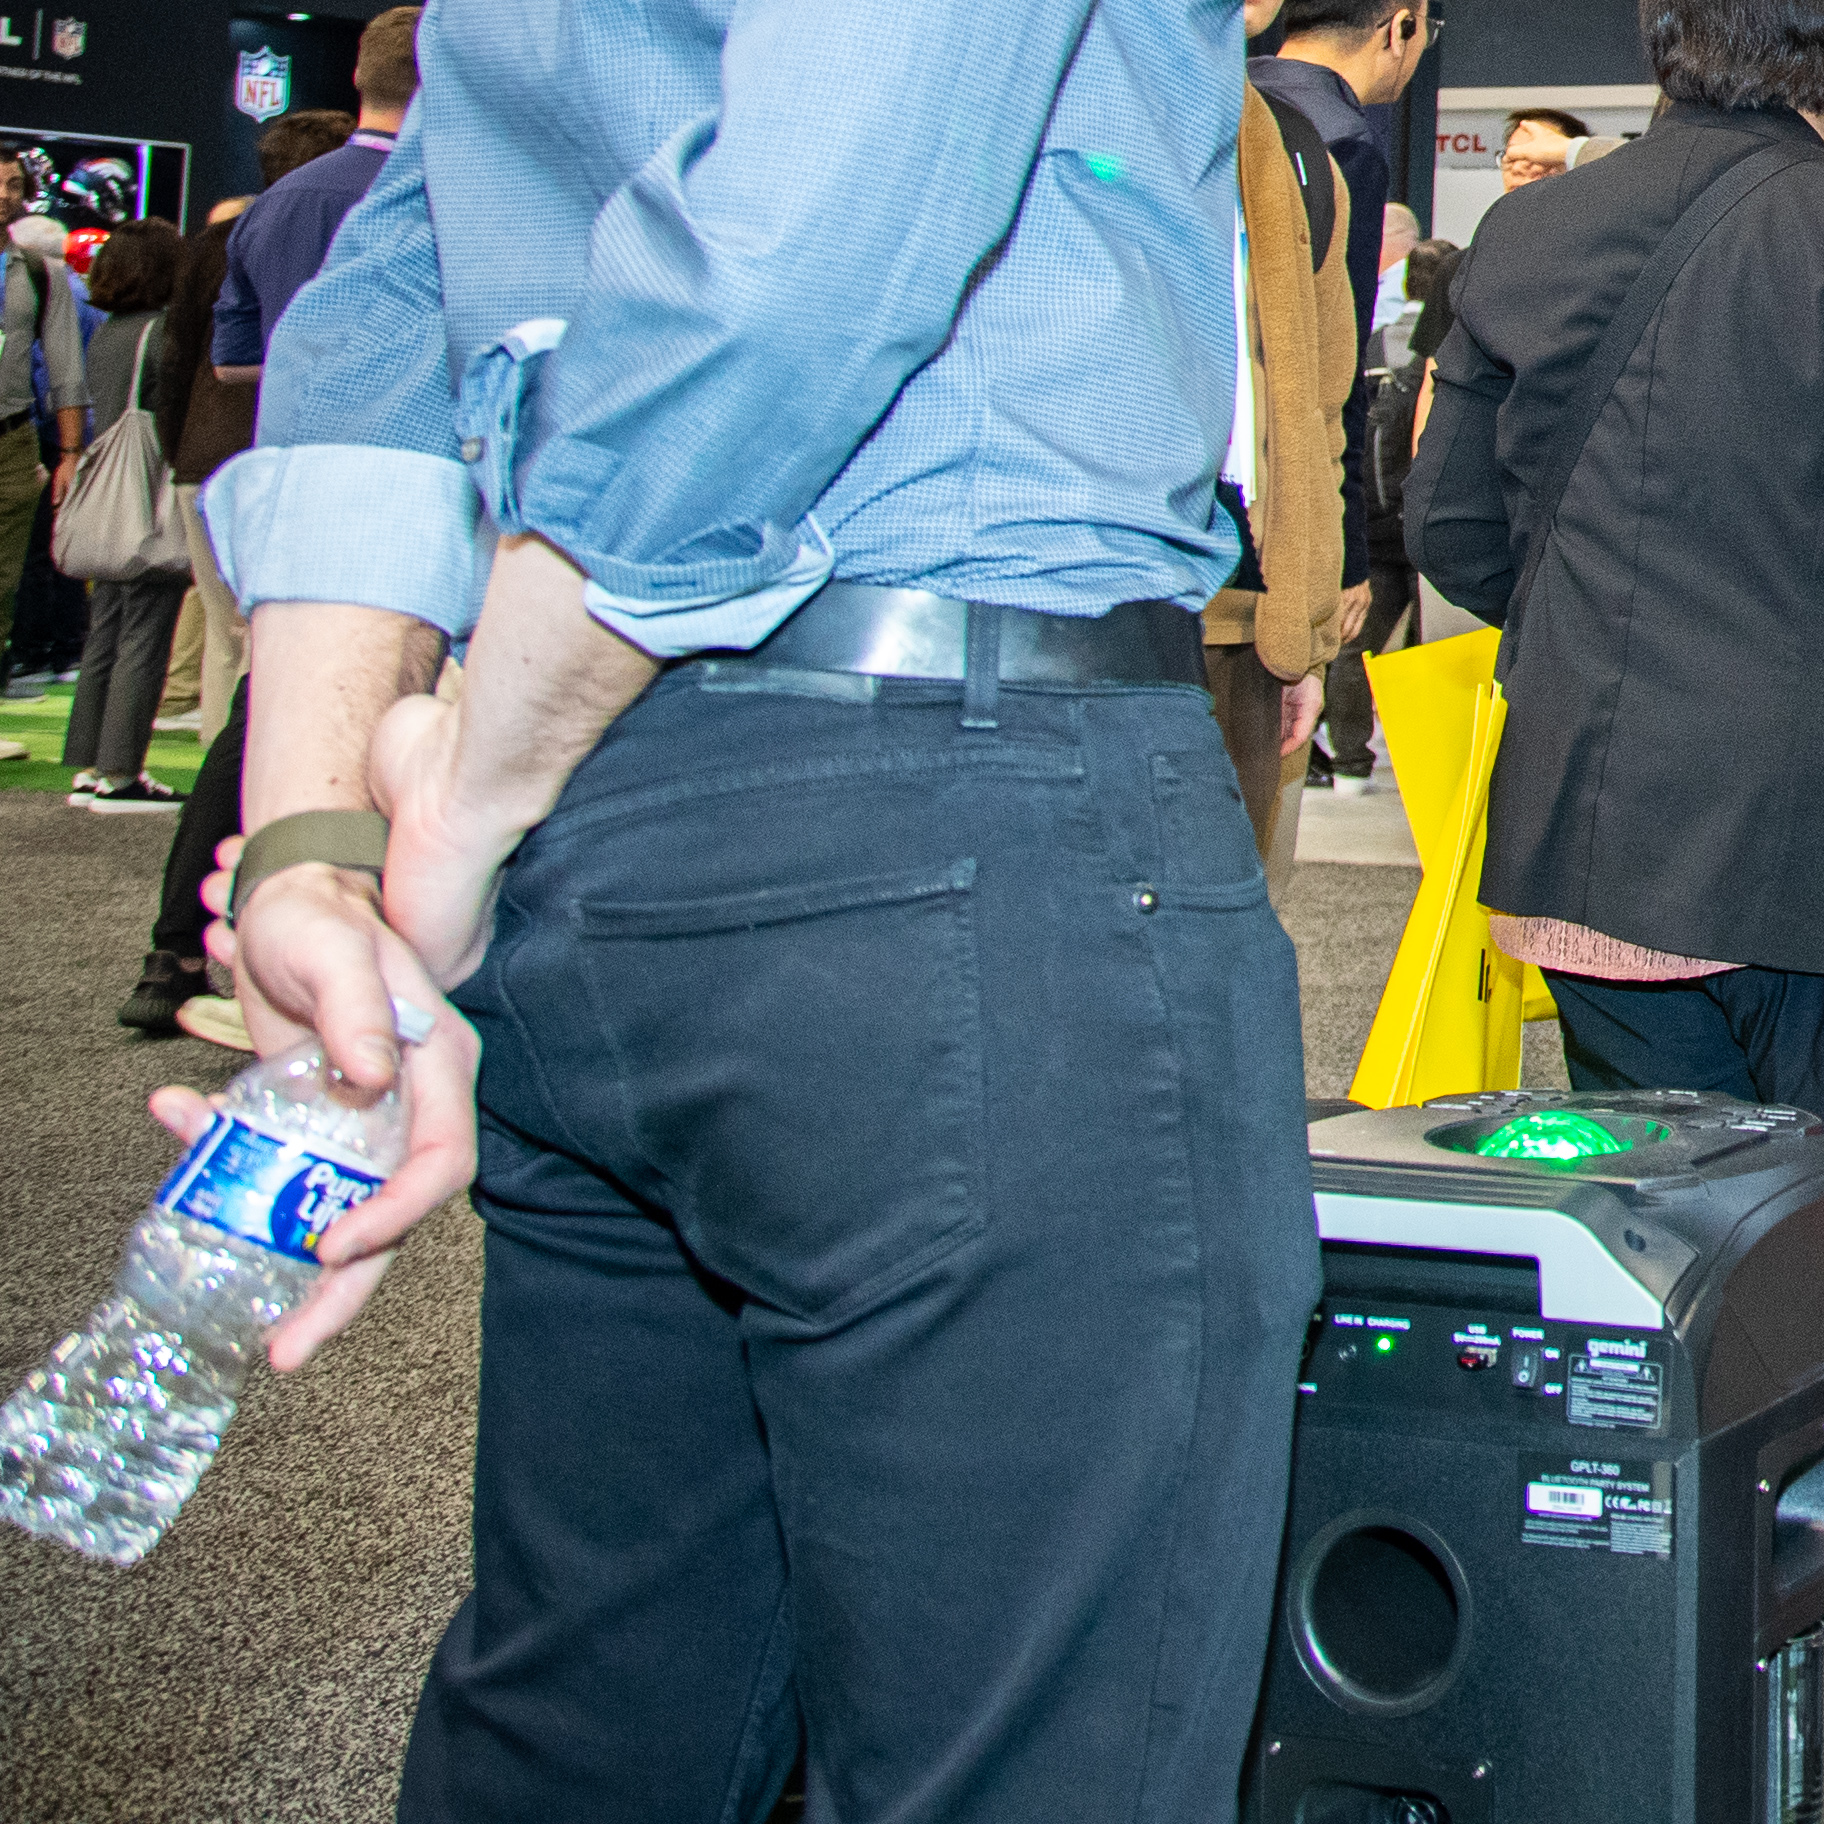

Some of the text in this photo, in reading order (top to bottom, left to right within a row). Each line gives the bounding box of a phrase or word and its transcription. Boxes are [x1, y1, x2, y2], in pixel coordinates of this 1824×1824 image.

[244, 78, 281, 108] NFL
[1438, 133, 1488, 154] TCL
[297, 1189, 348, 1233] Lif
[1587, 1338, 1648, 1359] gemini
